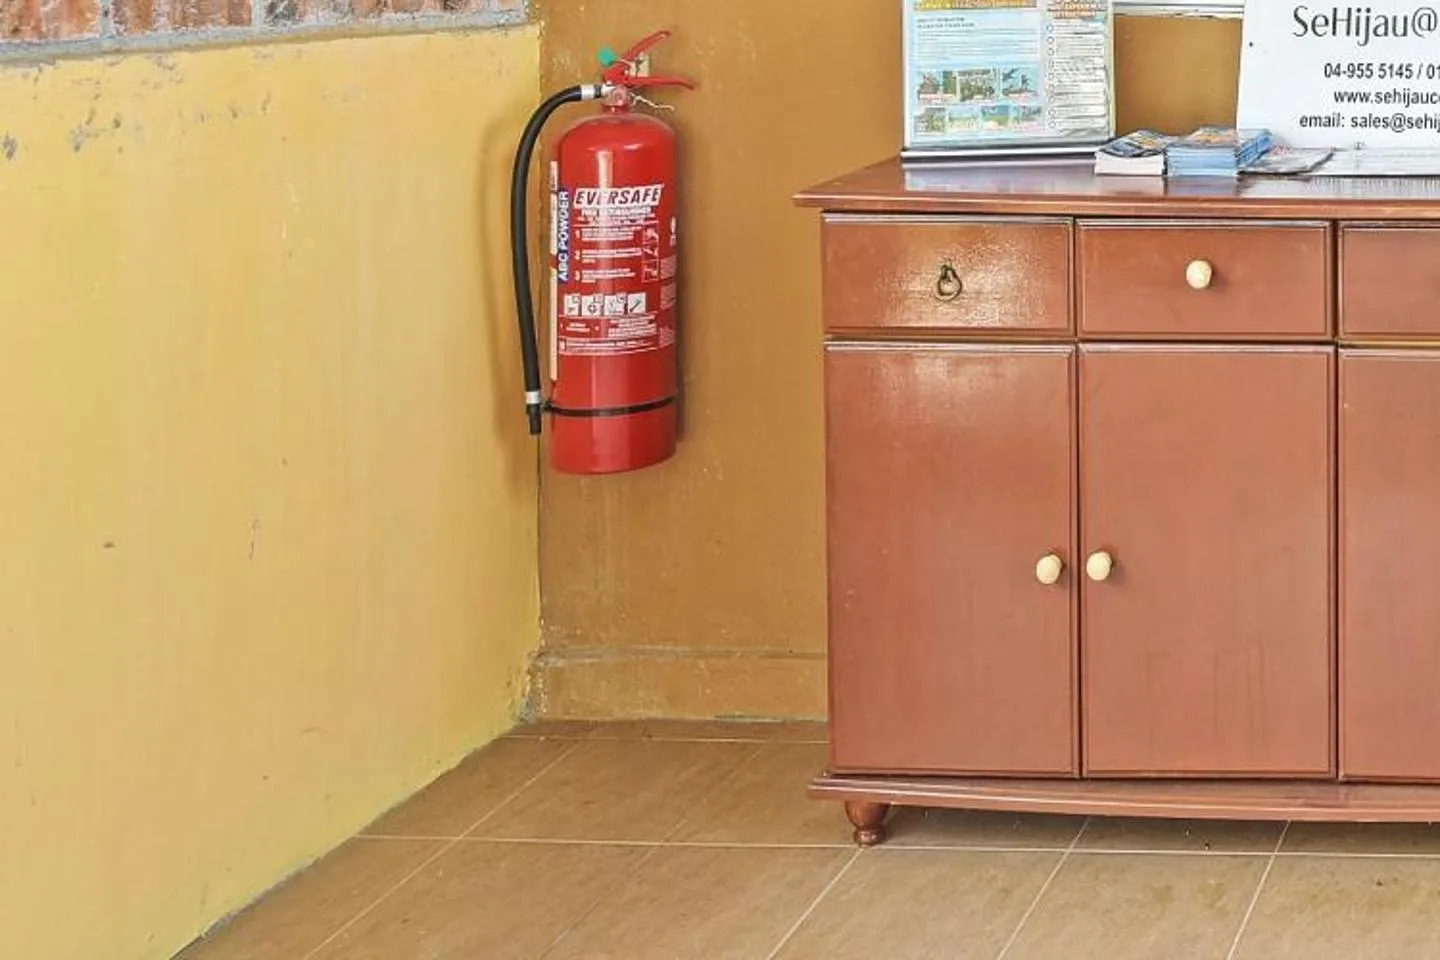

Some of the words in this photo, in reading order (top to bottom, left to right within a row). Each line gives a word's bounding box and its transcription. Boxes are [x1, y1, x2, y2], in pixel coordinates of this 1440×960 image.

[1324, 62, 1374, 79] 04-955
[1378, 62, 1414, 80] 5145
[1299, 113, 1346, 129] email:
[575, 189, 661, 206] EVRSAFE
[559, 191, 569, 250] POWDER
[559, 253, 569, 282] ABC
